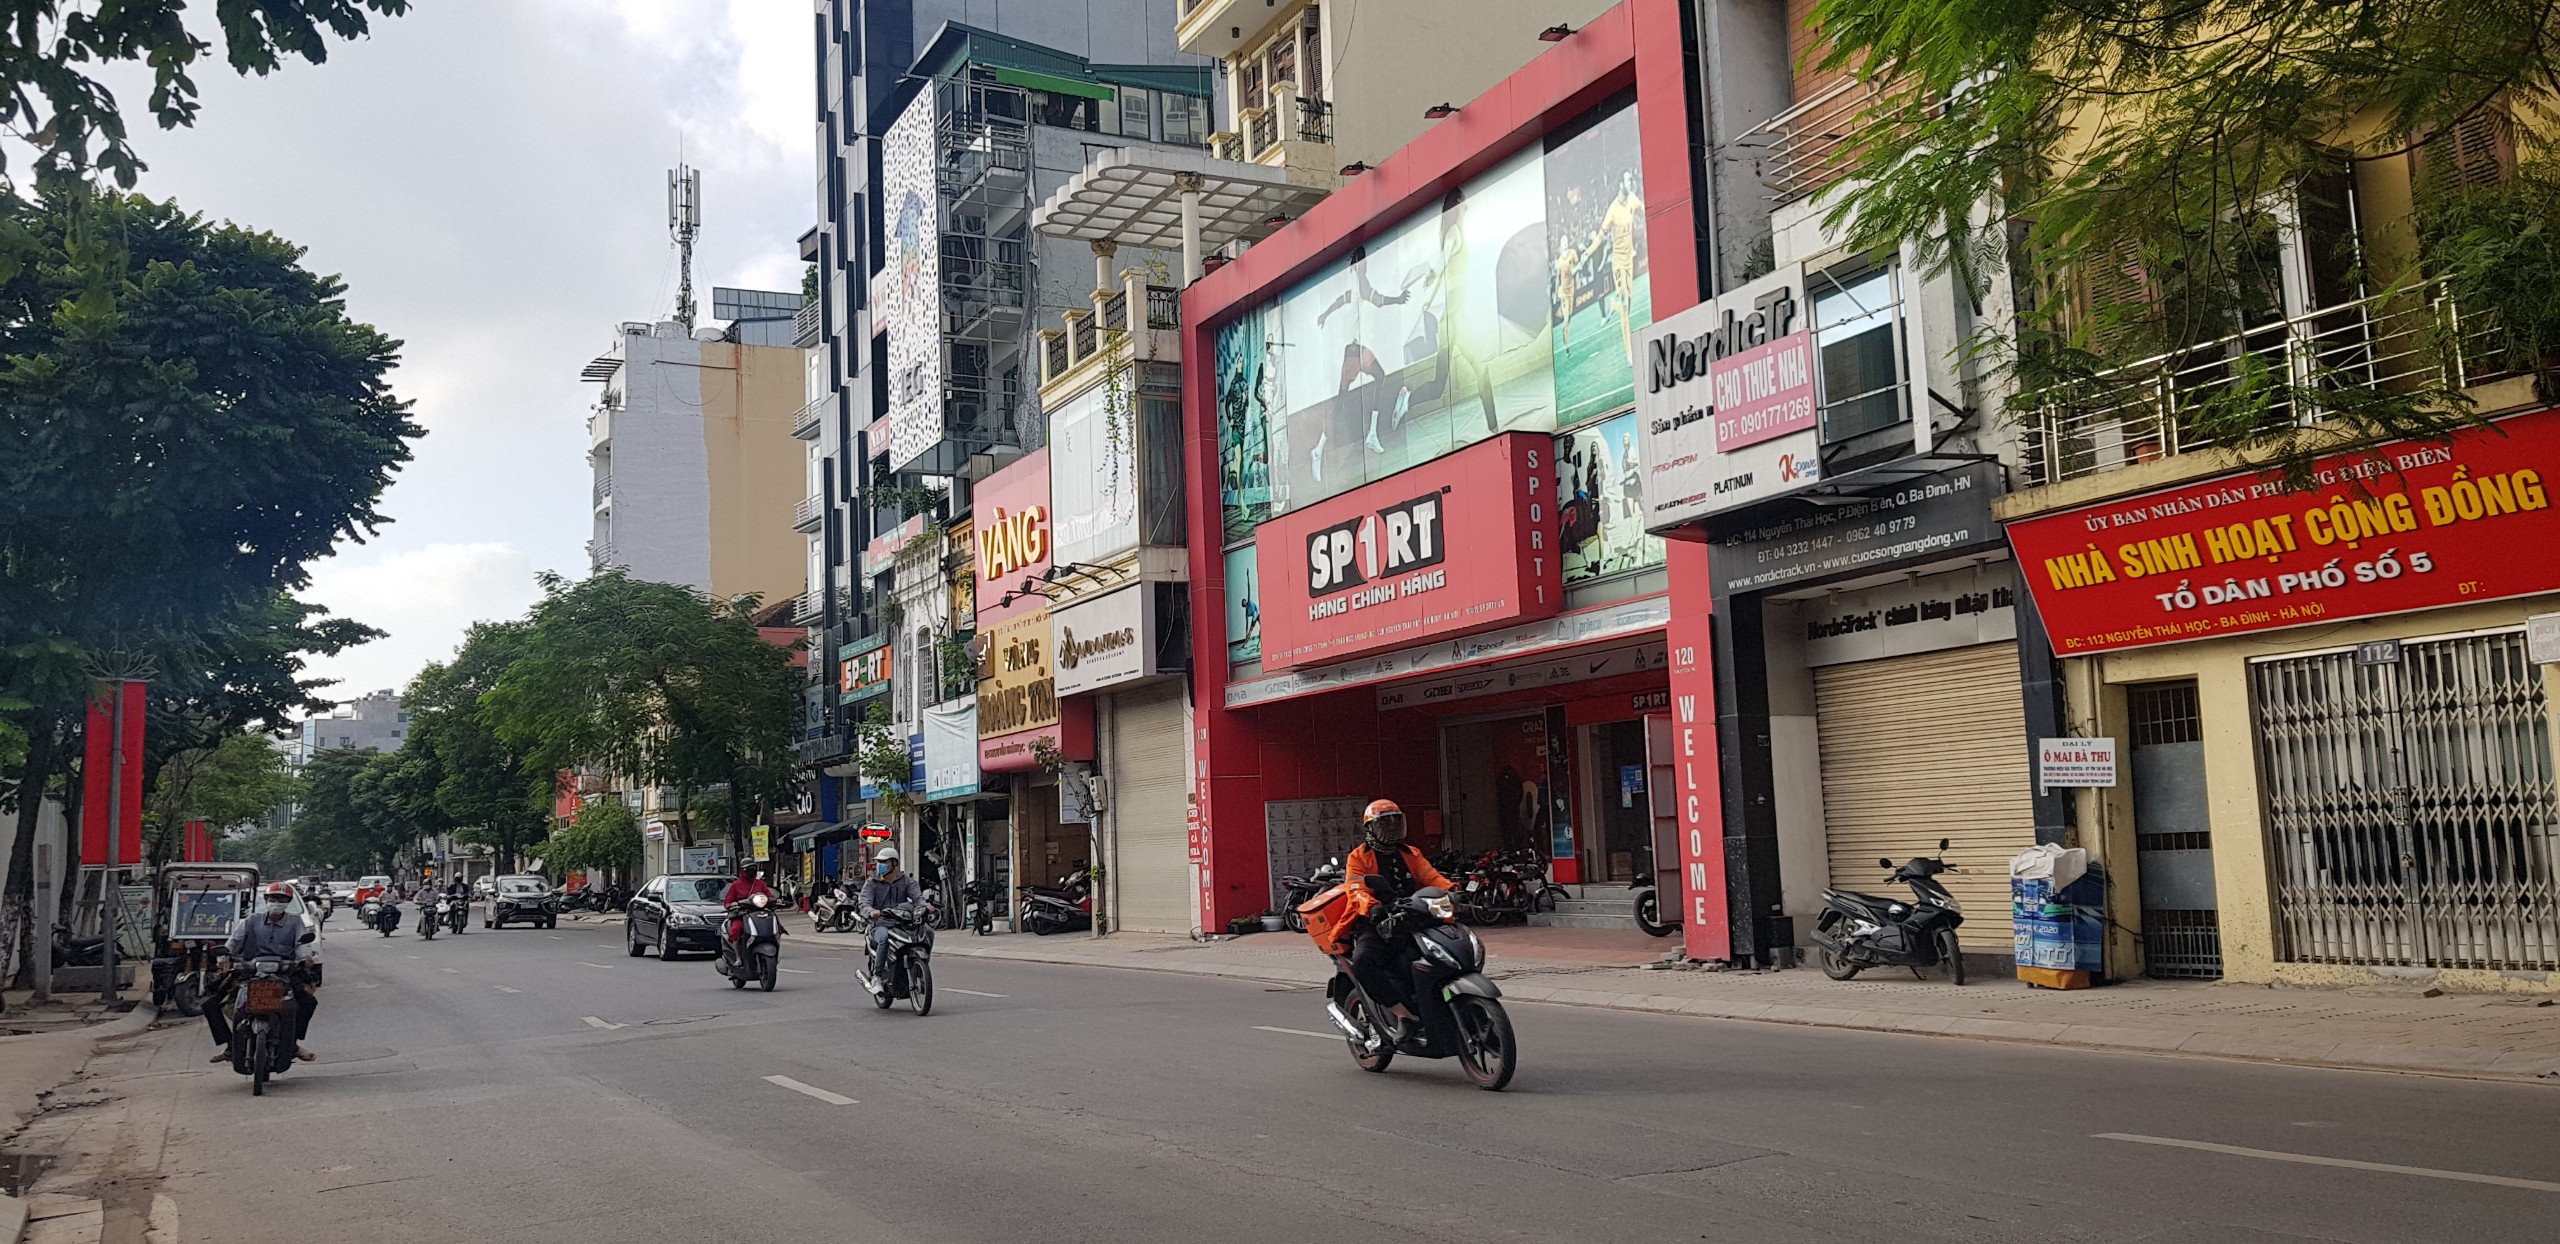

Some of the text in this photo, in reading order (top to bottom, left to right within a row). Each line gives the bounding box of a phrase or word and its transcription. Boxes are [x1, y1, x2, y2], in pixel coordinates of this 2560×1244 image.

[1716, 337, 1809, 412] CHO THUÊ NHÀ
[1651, 419, 1671, 436] Sản
[1719, 419, 1739, 442] ĐT:
[1741, 396, 1811, 436] 0901771269
[1714, 472, 1754, 495] PLATINUM
[2085, 511, 2109, 532] ỦY
[2112, 507, 2149, 527] BAN
[2151, 497, 2204, 520] NHÂN
[2206, 487, 2248, 508] DÂN
[2398, 446, 2453, 472] BIÊN
[1744, 528, 1757, 543] 114
[1896, 491, 1909, 506] Q.
[1909, 488, 1925, 502] Ba
[1954, 475, 1972, 491] HN
[2044, 464, 2549, 590] NHÀ SINH HOẠT CỘNG ĐỒNG
[979, 504, 1047, 581] VÀNG
[1758, 549, 1772, 563] ĐT:
[1773, 548, 1785, 560] 04
[1787, 541, 1809, 557] 3232
[1811, 535, 1834, 551] 1447
[1846, 527, 1871, 545] 0962
[1874, 523, 1886, 537] 40
[1823, 530, 1969, 570] www.cuocsongnangdong.vn
[2155, 548, 2434, 612] TỔ DÂN PHỐ SỐ 5
[2458, 581, 2478, 595] ĐT
[1309, 597, 1348, 621] HÀNG
[1352, 583, 1396, 610] CHÍNH
[1808, 611, 1878, 640] NordicTrack
[1885, 603, 1918, 627] chính
[1955, 592, 1989, 617] nhập
[2065, 636, 2086, 649] ĐC:
[2087, 633, 2105, 646] 112
[2106, 624, 2153, 644] NGUYỄN
[2154, 620, 2182, 637] THÁI
[2184, 618, 2212, 635] HỌC
[2220, 614, 2239, 628] BA
[2240, 609, 2271, 626] ĐÌNH
[2279, 604, 2300, 620] HÀ
[2301, 602, 2326, 618] NỘI
[1675, 646, 1695, 666] 120
[2362, 643, 2395, 662] 112
[2044, 748, 2111, 763] Ô MAI BÀ THU
[1678, 694, 1707, 926] WELCOME
[1198, 759, 1211, 911] WELCOME
[194, 913, 218, 927] F4
[2039, 926, 2059, 935] 2020
